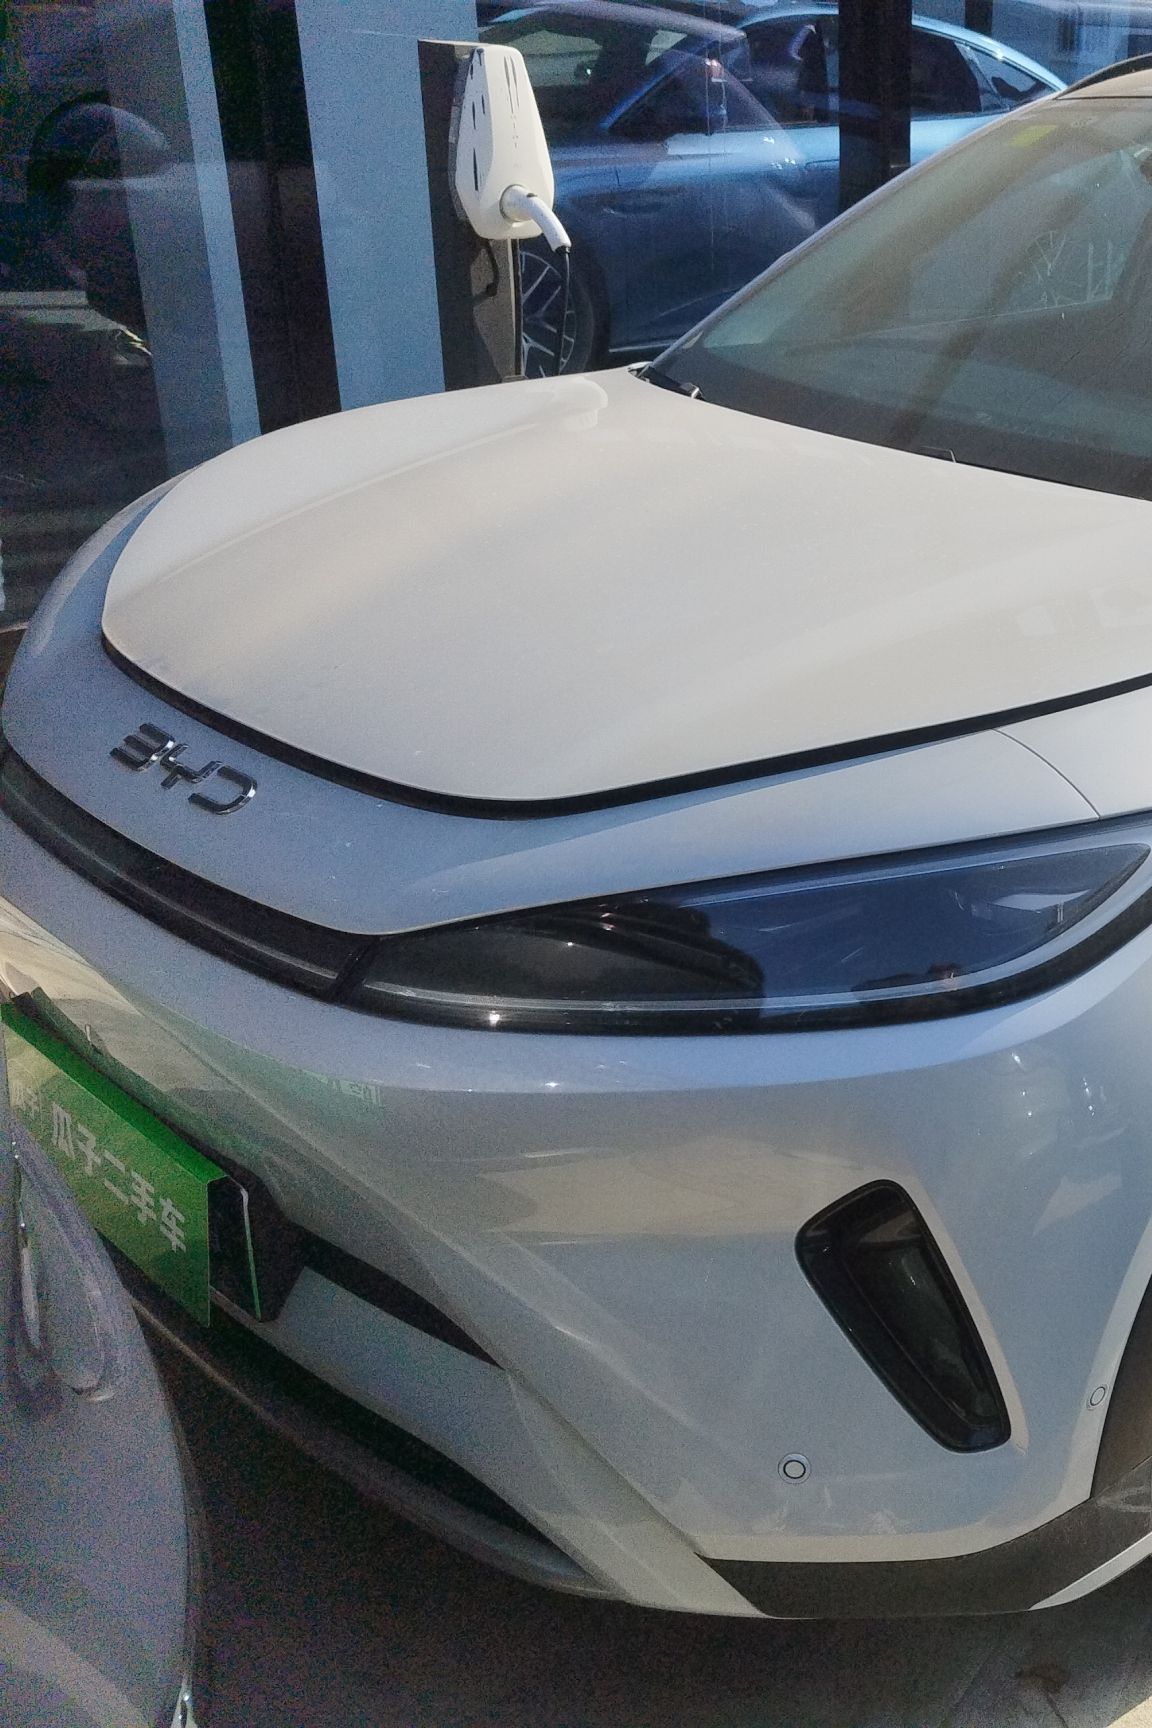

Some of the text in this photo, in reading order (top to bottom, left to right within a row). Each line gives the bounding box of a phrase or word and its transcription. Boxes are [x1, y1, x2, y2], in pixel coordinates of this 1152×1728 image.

[110, 723, 257, 816] BYD
[51, 1101, 187, 1254] 瓜子二手车
